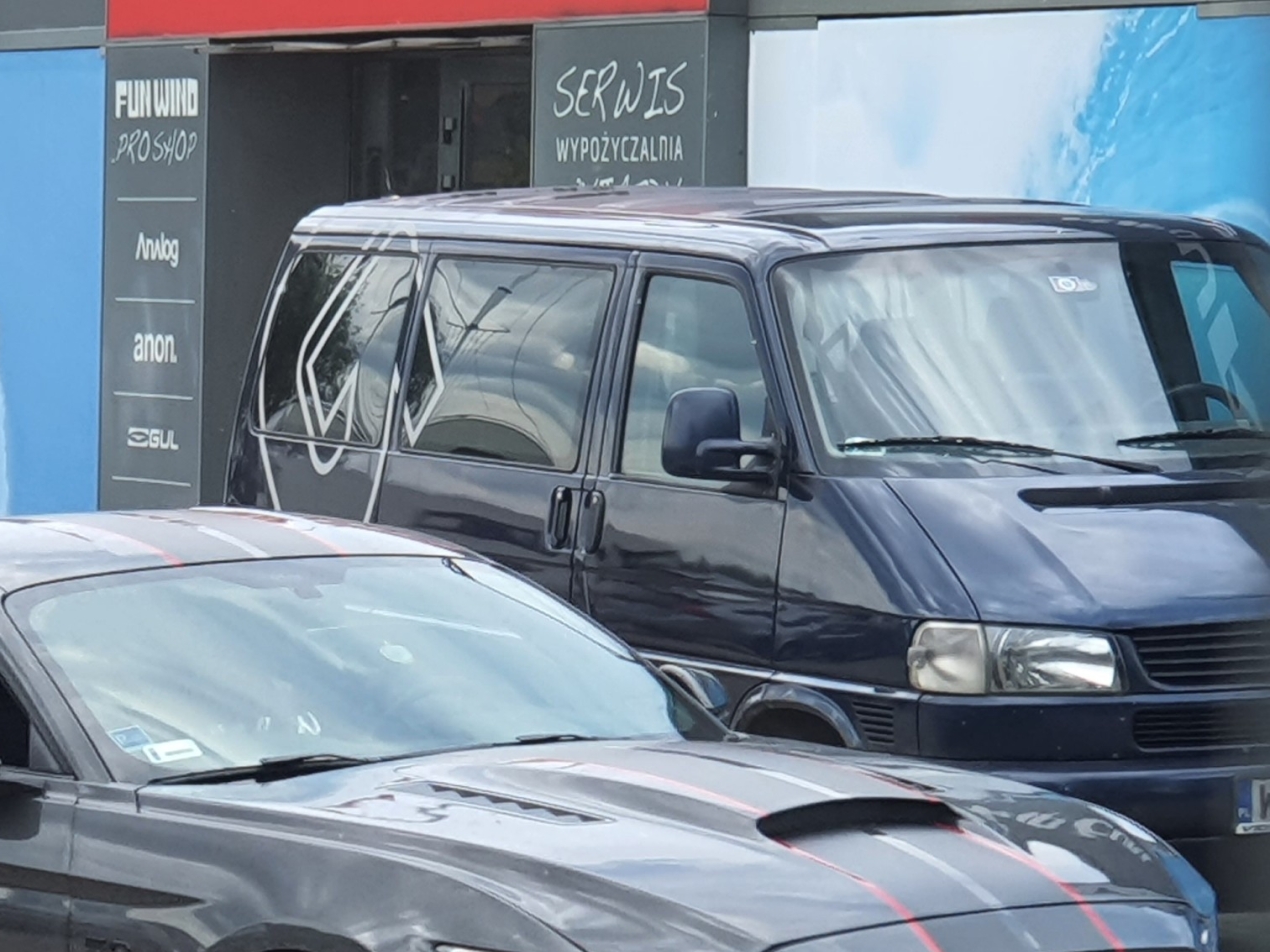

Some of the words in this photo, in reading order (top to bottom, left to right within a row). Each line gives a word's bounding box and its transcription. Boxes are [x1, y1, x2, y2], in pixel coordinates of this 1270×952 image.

[115, 79, 152, 118] FUN
[153, 78, 198, 117] WIND
[553, 60, 687, 122] SERWIS
[555, 131, 684, 163] WYPOŻYCZALNIA
[150, 428, 179, 450] GUL
